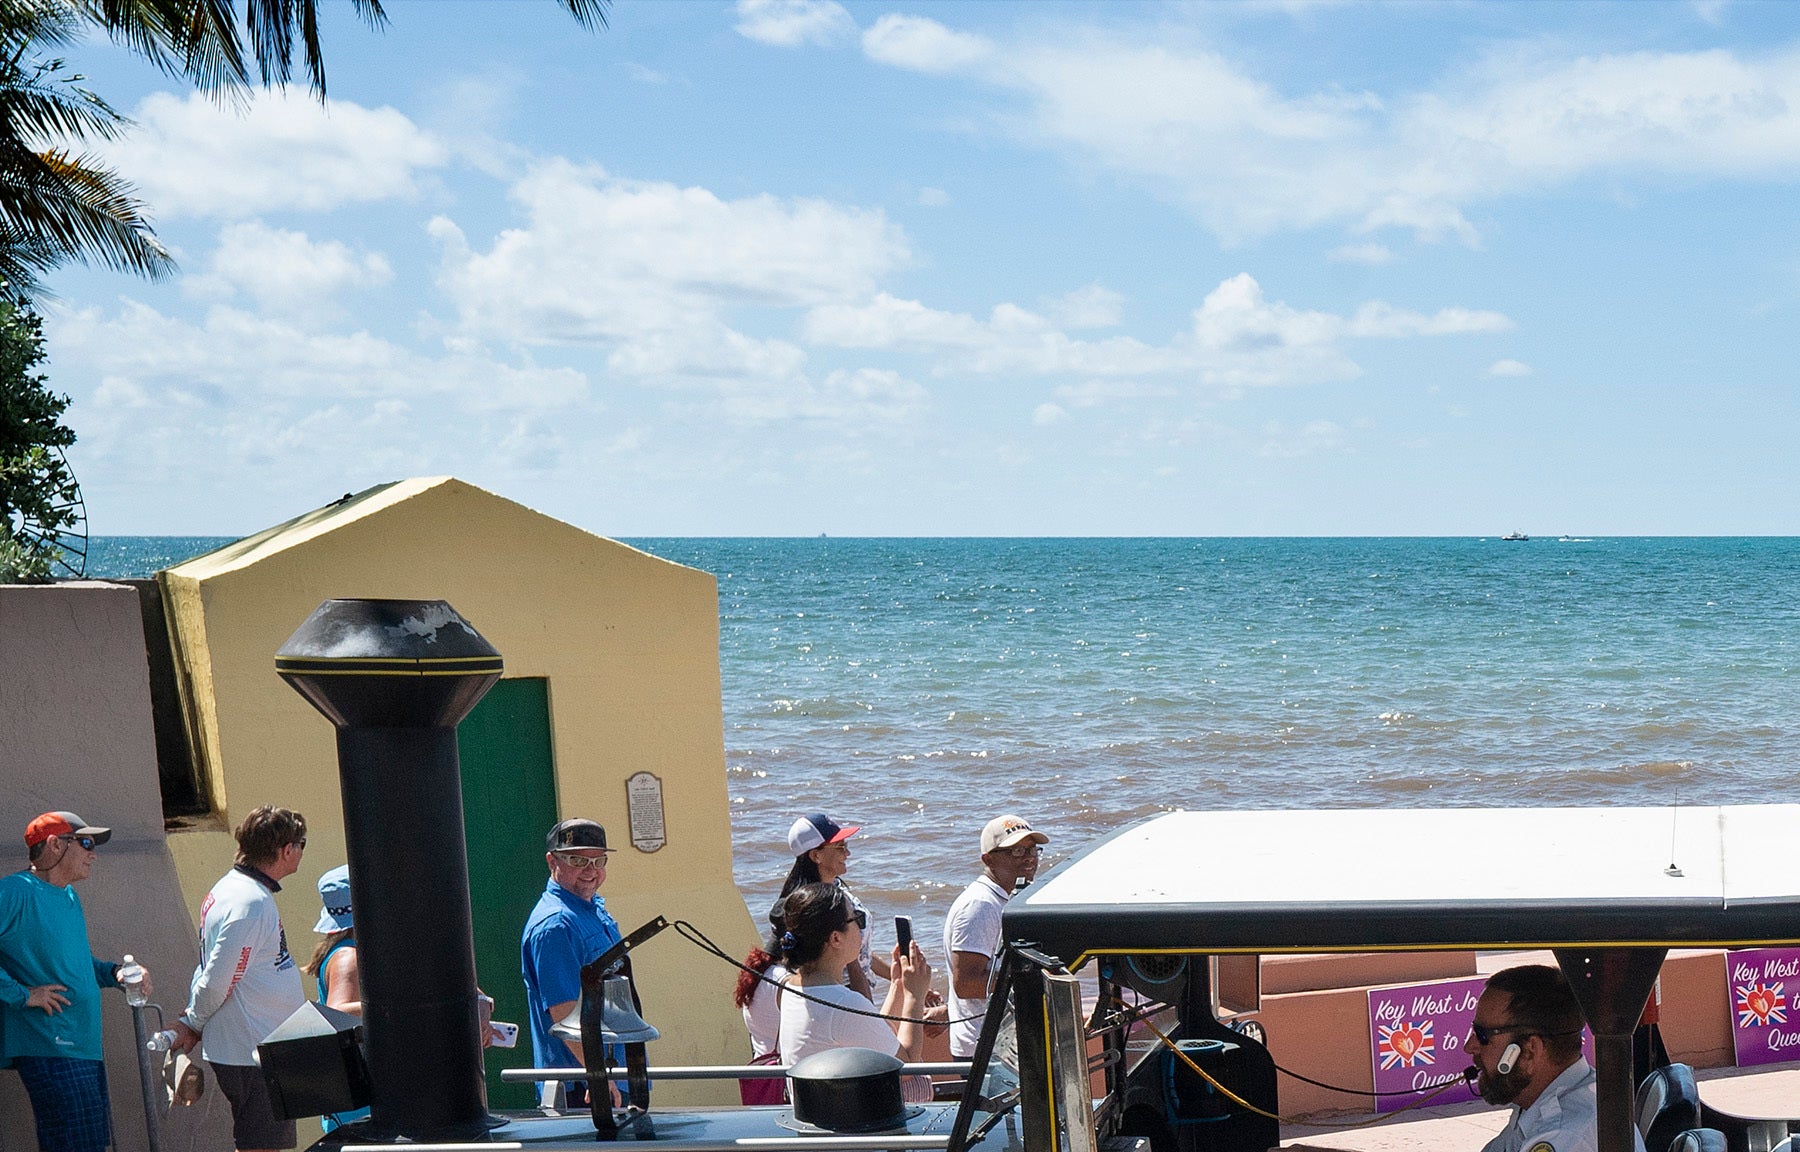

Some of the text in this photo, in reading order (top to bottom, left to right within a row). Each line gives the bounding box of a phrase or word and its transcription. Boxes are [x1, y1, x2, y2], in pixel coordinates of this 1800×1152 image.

[1733, 962, 1759, 990] Key
[1764, 958, 1799, 979] West
[1375, 999, 1406, 1030] Key
[1411, 994, 1452, 1017] West
[1443, 1032, 1458, 1050] to
